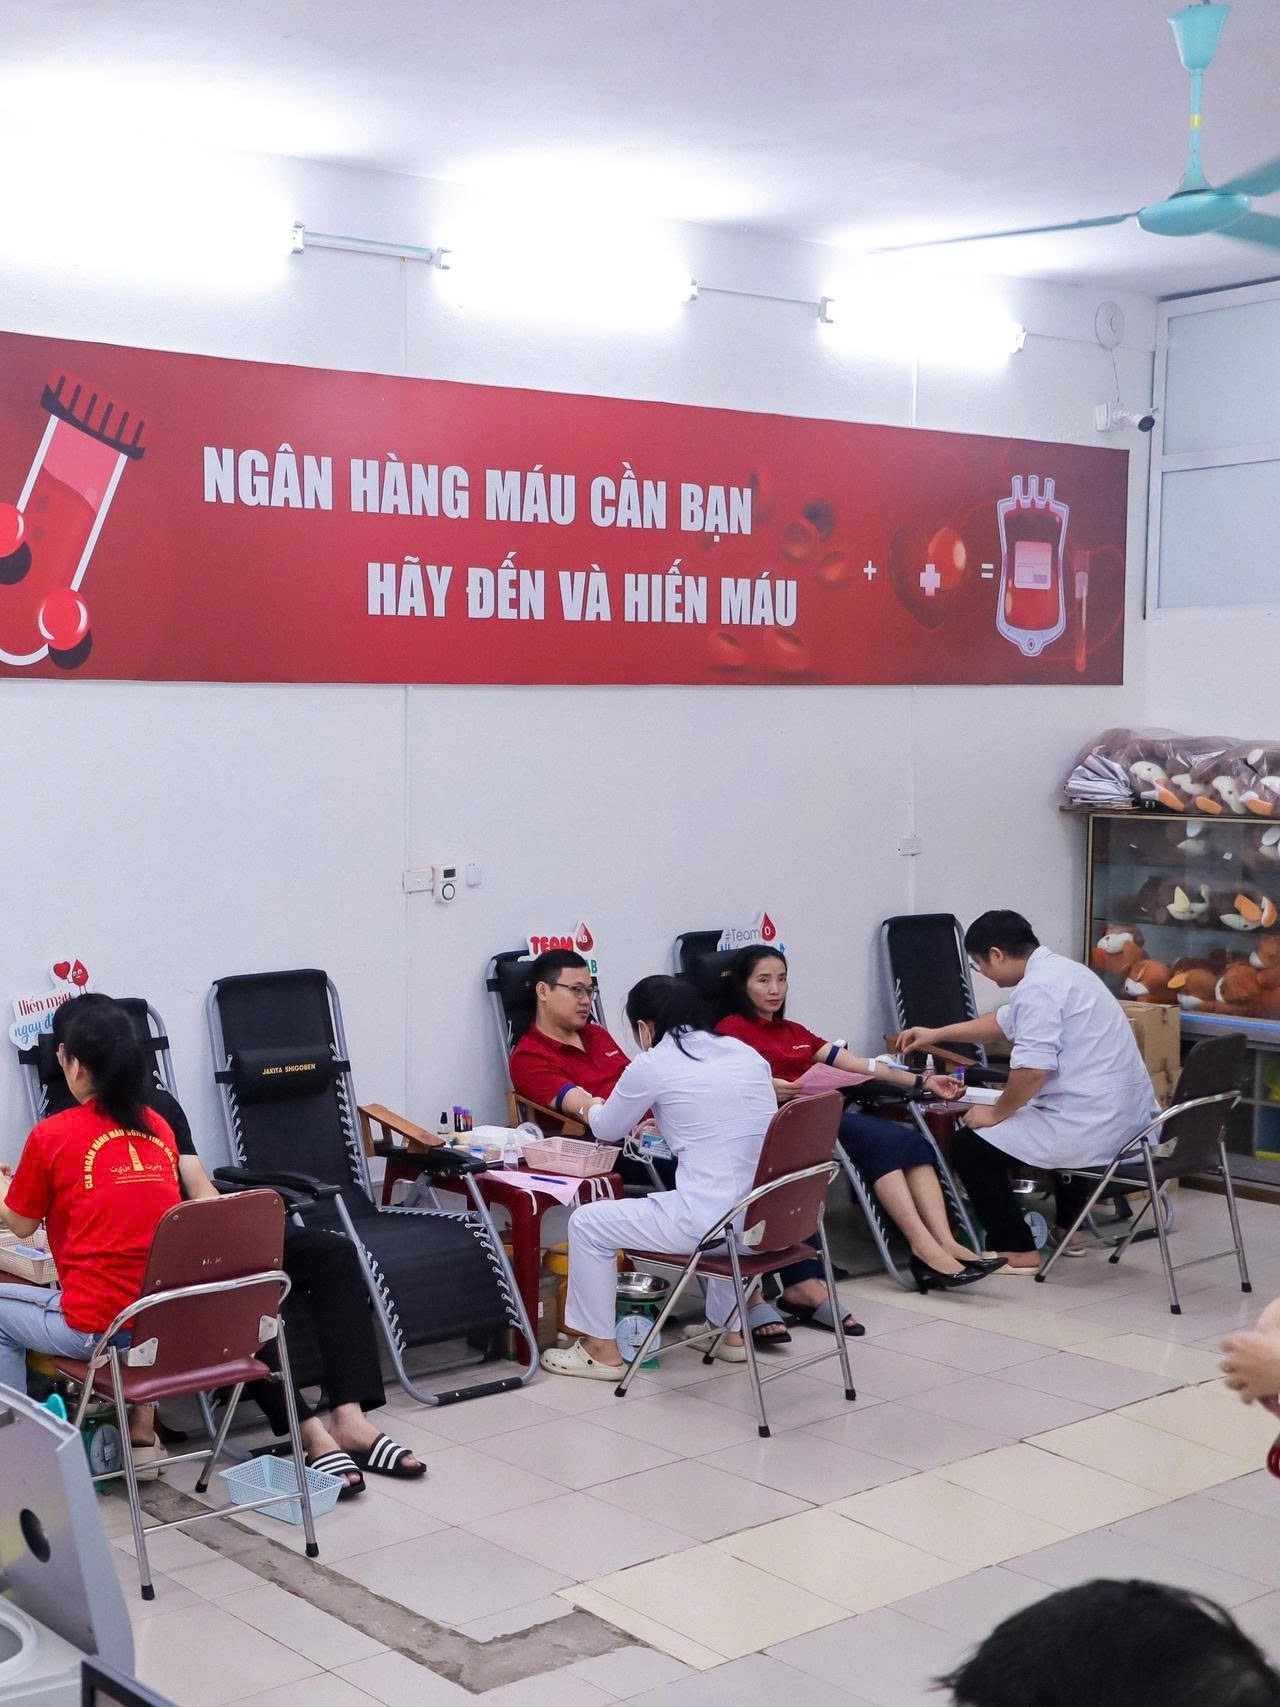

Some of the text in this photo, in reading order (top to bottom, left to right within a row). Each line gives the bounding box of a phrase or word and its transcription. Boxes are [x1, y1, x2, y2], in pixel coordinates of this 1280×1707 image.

[203, 442, 752, 543] NGÂN HÀNG MÁU CẦN BẠN
[367, 551, 797, 627] HÃY ĐẾN VÀ HIẾN MÁU
[530, 936, 574, 955] TEAM
